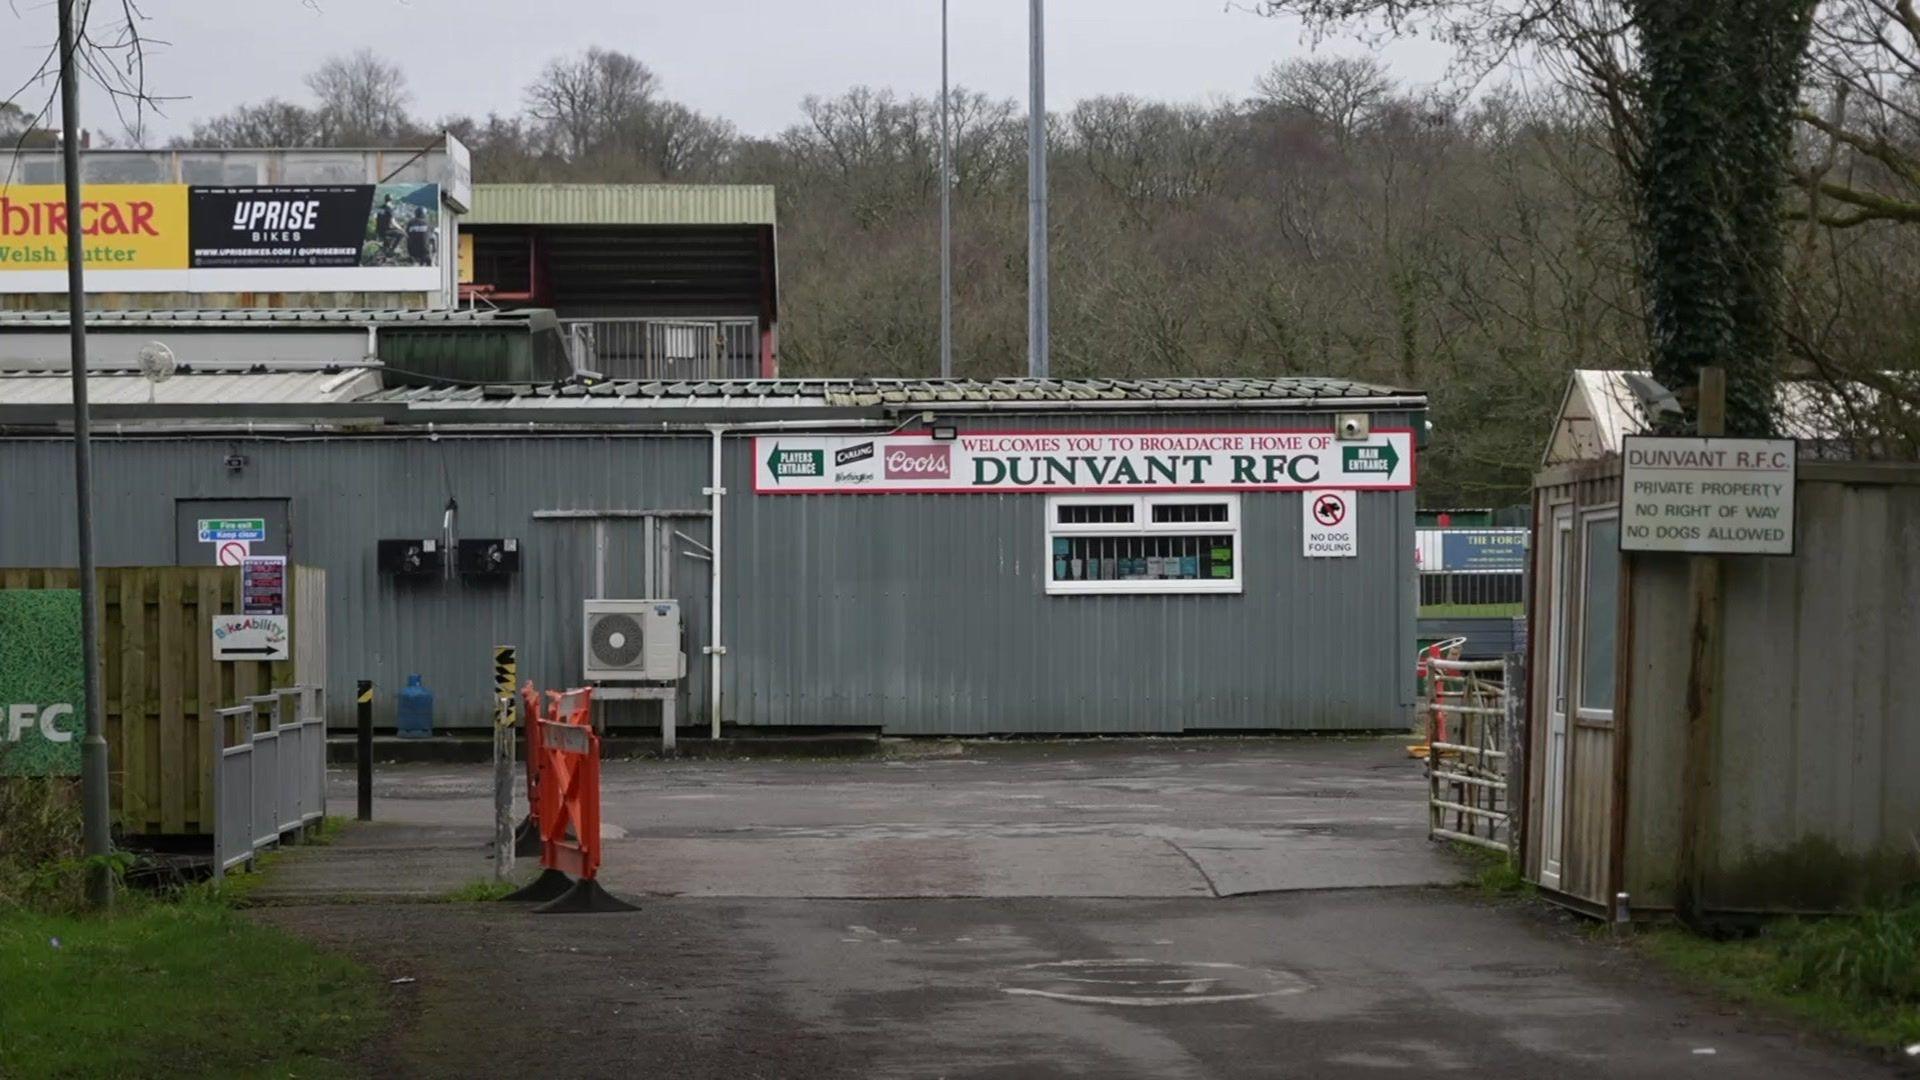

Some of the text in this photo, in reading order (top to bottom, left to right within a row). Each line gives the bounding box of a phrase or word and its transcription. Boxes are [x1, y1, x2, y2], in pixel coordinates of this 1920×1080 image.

[232, 201, 320, 230] UPRISE
[252, 231, 301, 242] BIKES
[64, 246, 136, 262] utter
[961, 437, 1331, 452] WELCOMES YOU TO BROADACRE HOME OF
[780, 452, 813, 463] PLAYERS
[1358, 448, 1379, 459] MAIN
[1629, 451, 1791, 469] DUNVANT R.F.C.
[778, 463, 816, 474] ENTRANCE
[886, 450, 948, 473] Coors
[1348, 459, 1388, 470] ENTRANCE
[972, 454, 1320, 485] DUNVANT RFC
[1634, 481, 1783, 497] PRIVATE PROPERTY
[1636, 504, 1780, 519] NO RIGHT OF WAY
[1311, 533, 1349, 541] NO DOG
[1467, 536, 1487, 544] THE
[1627, 525, 1785, 541] NO DOGS ALLOWED
[1309, 543, 1351, 552] FOULING
[0, 703, 74, 743] FC
